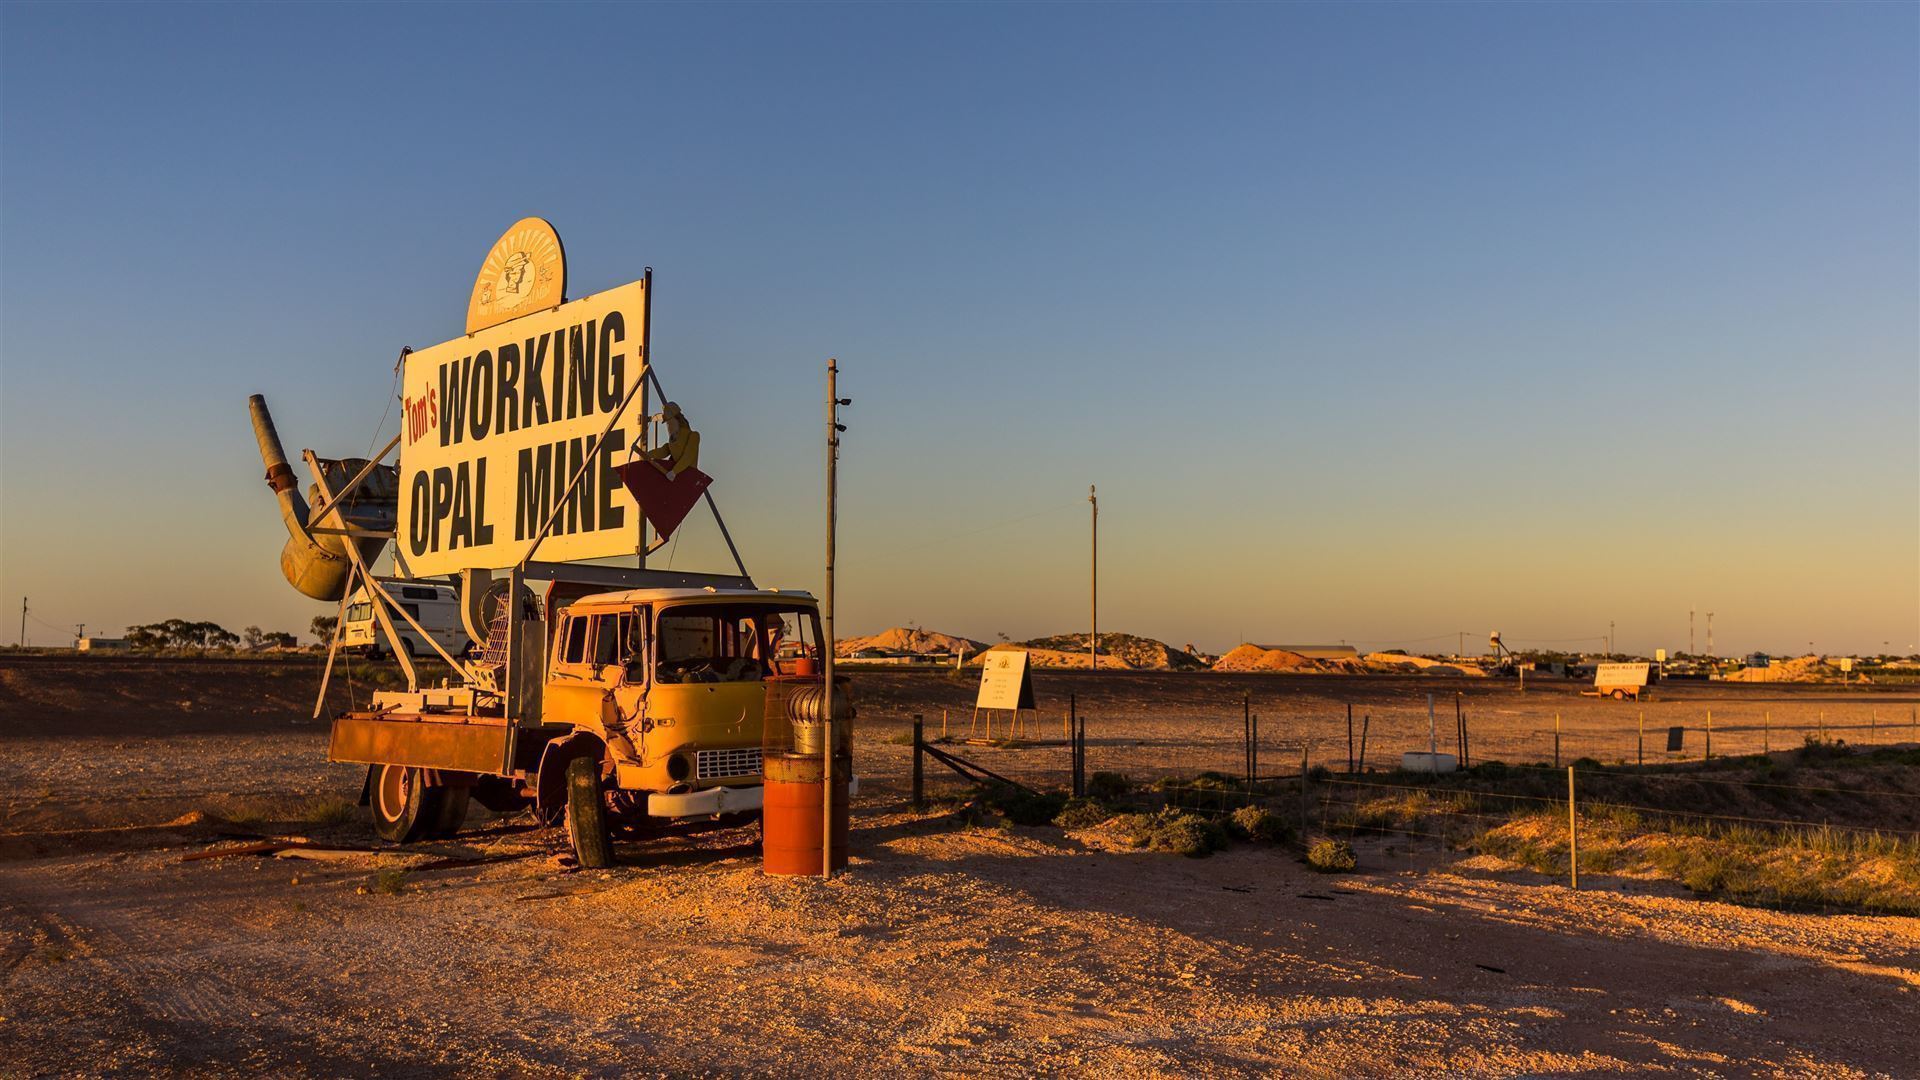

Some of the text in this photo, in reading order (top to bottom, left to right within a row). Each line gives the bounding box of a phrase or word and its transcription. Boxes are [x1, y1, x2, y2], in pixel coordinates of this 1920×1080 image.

[405, 311, 625, 448] Tom's WORKING
[409, 428, 625, 557] OPAL MINE
